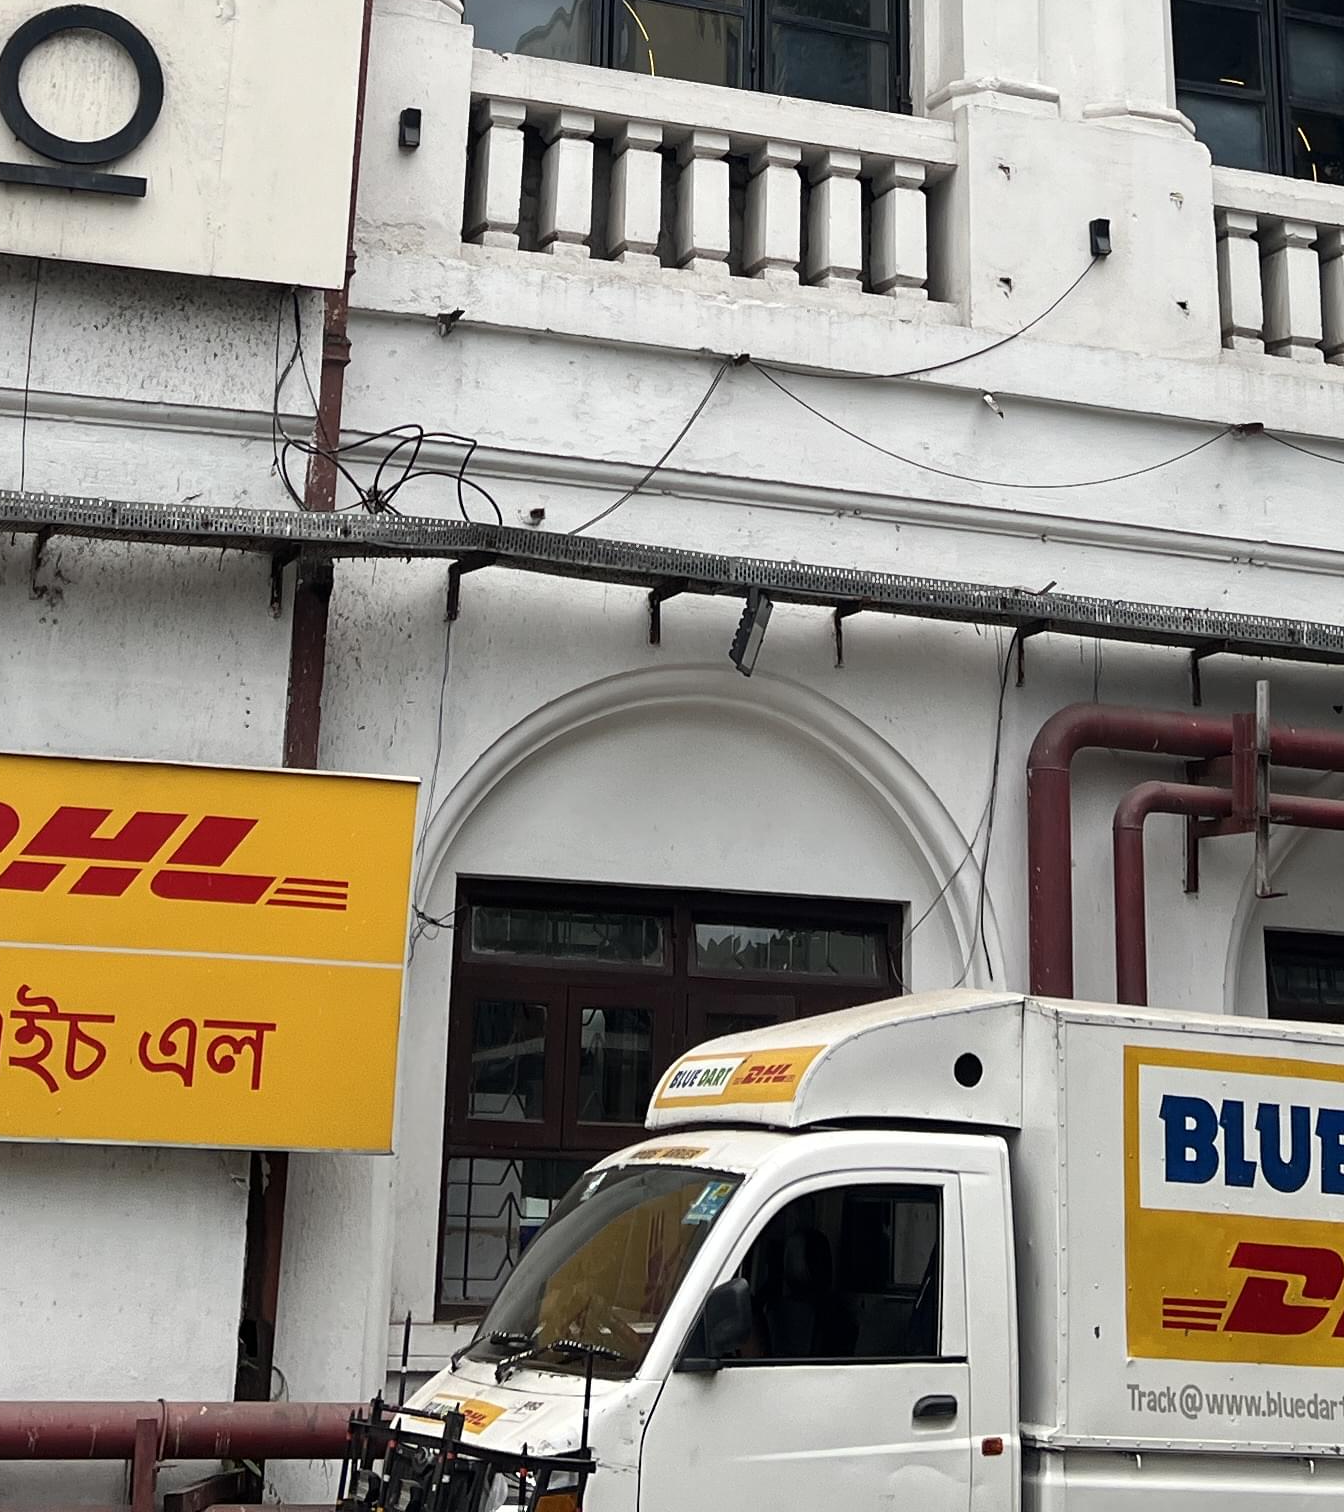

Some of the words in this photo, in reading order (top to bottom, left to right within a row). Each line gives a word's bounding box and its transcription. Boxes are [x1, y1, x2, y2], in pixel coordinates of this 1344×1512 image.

[137, 1016, 277, 1091] এল
[668, 1068, 701, 1089] BLUE
[696, 1066, 735, 1087] DART
[741, 1063, 793, 1085] DHL
